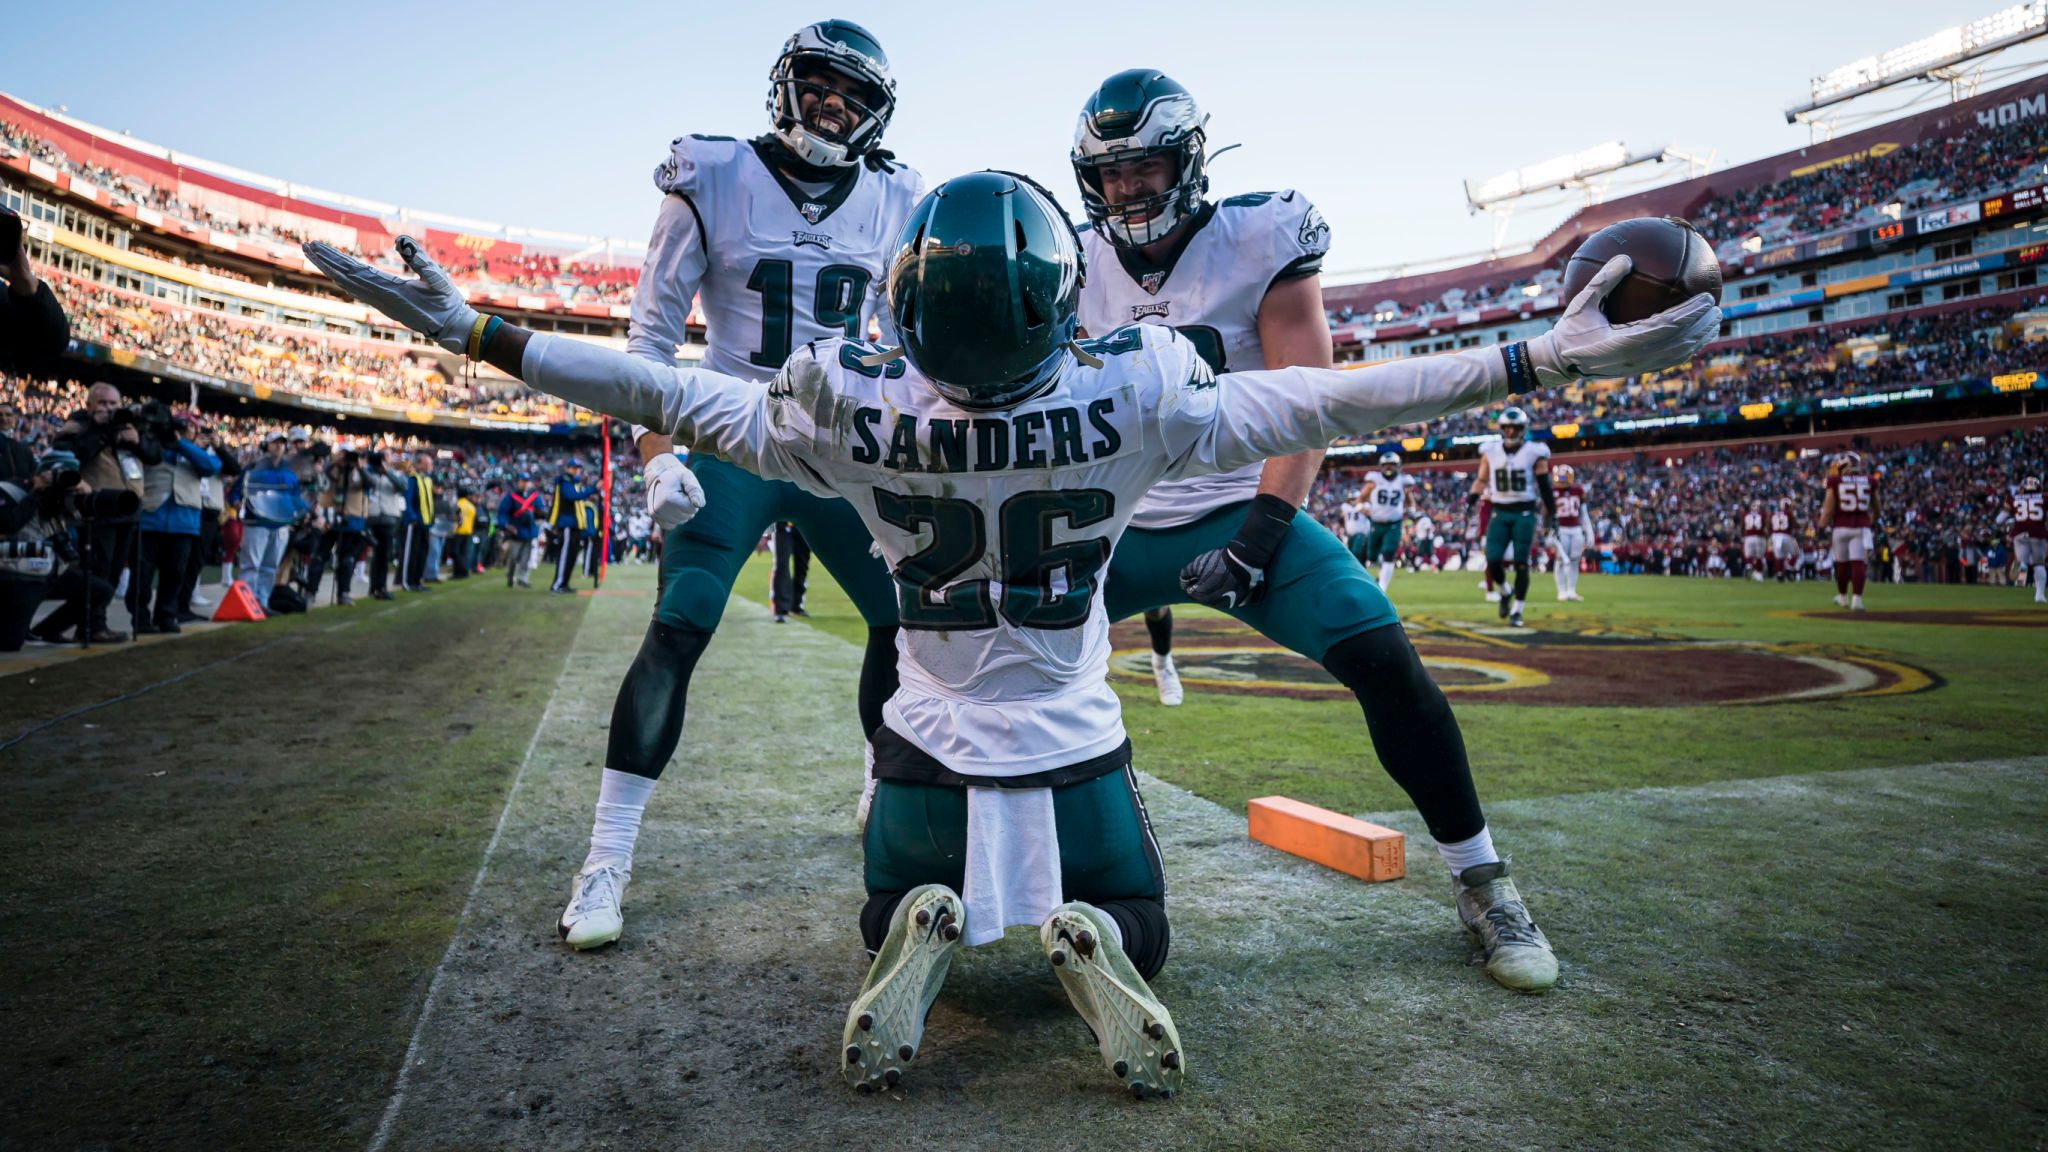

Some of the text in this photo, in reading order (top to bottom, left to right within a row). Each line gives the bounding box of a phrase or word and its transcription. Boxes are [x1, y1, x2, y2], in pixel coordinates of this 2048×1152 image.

[1920, 208, 1969, 230] FedEx
[792, 230, 833, 250] EAGLES
[1923, 260, 1980, 280] Merrill Lynch
[746, 258, 873, 369] 19
[1131, 300, 1171, 321] EAGLES
[1991, 371, 2038, 387] GEICO
[852, 397, 1121, 473] SANDERS
[1377, 488, 1401, 506] 62
[1838, 483, 1871, 511] 55
[2013, 498, 2044, 522] 35
[872, 486, 1116, 631] 26
